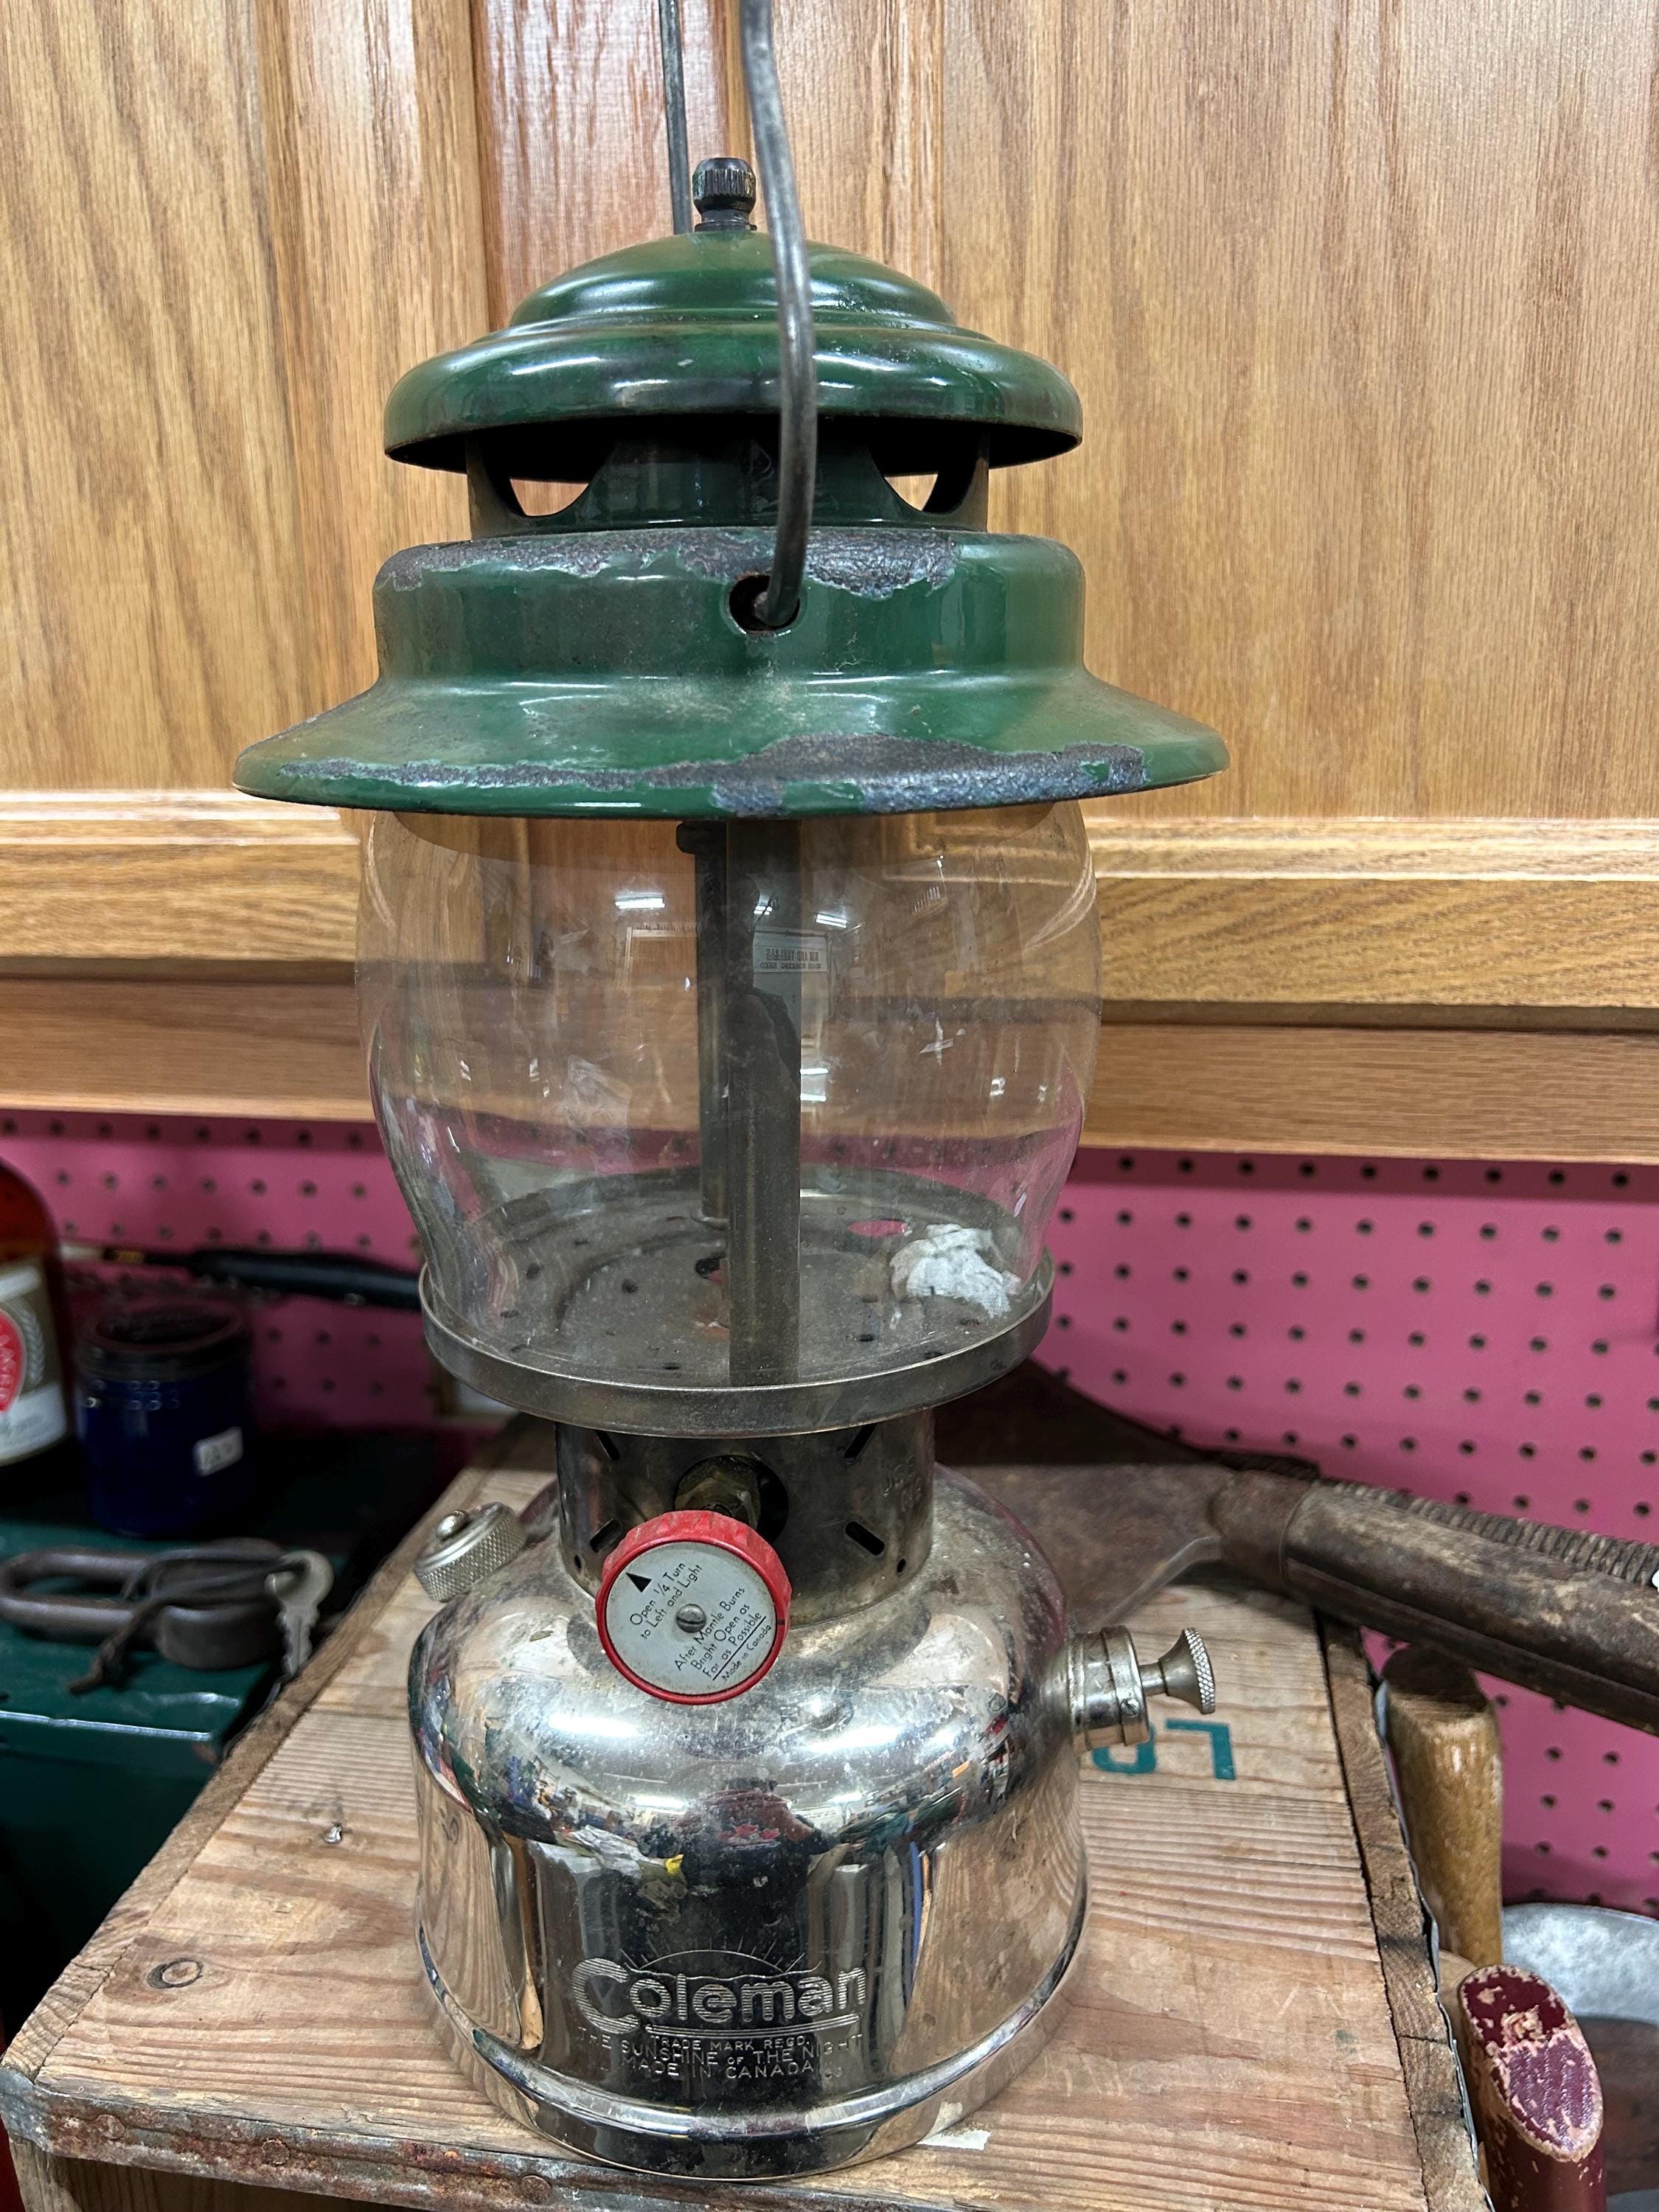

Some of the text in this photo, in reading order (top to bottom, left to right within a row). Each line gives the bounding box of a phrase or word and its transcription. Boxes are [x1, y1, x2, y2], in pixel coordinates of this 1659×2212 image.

[630, 1600, 656, 1625] Open
[663, 1563, 686, 1581] Turn
[641, 1565, 702, 1638] to Left and Light
[675, 1587, 745, 1671] After Mantle Burns
[691, 1604, 750, 1669] Bright Open as
[703, 1613, 762, 1677] Far as Possible
[722, 1660, 742, 1681] Made
[746, 1625, 771, 1650] Canada
[571, 1958, 866, 2034] Coleman
[577, 2026, 863, 2066] THE SUNSHINE OF THE NIGHT
[621, 2056, 680, 2077] MADE
[692, 2065, 712, 2078] IN
[725, 2060, 814, 2079] CANADA
[650, 2035, 701, 2051] TRADE
[710, 2040, 754, 2051] MARK
